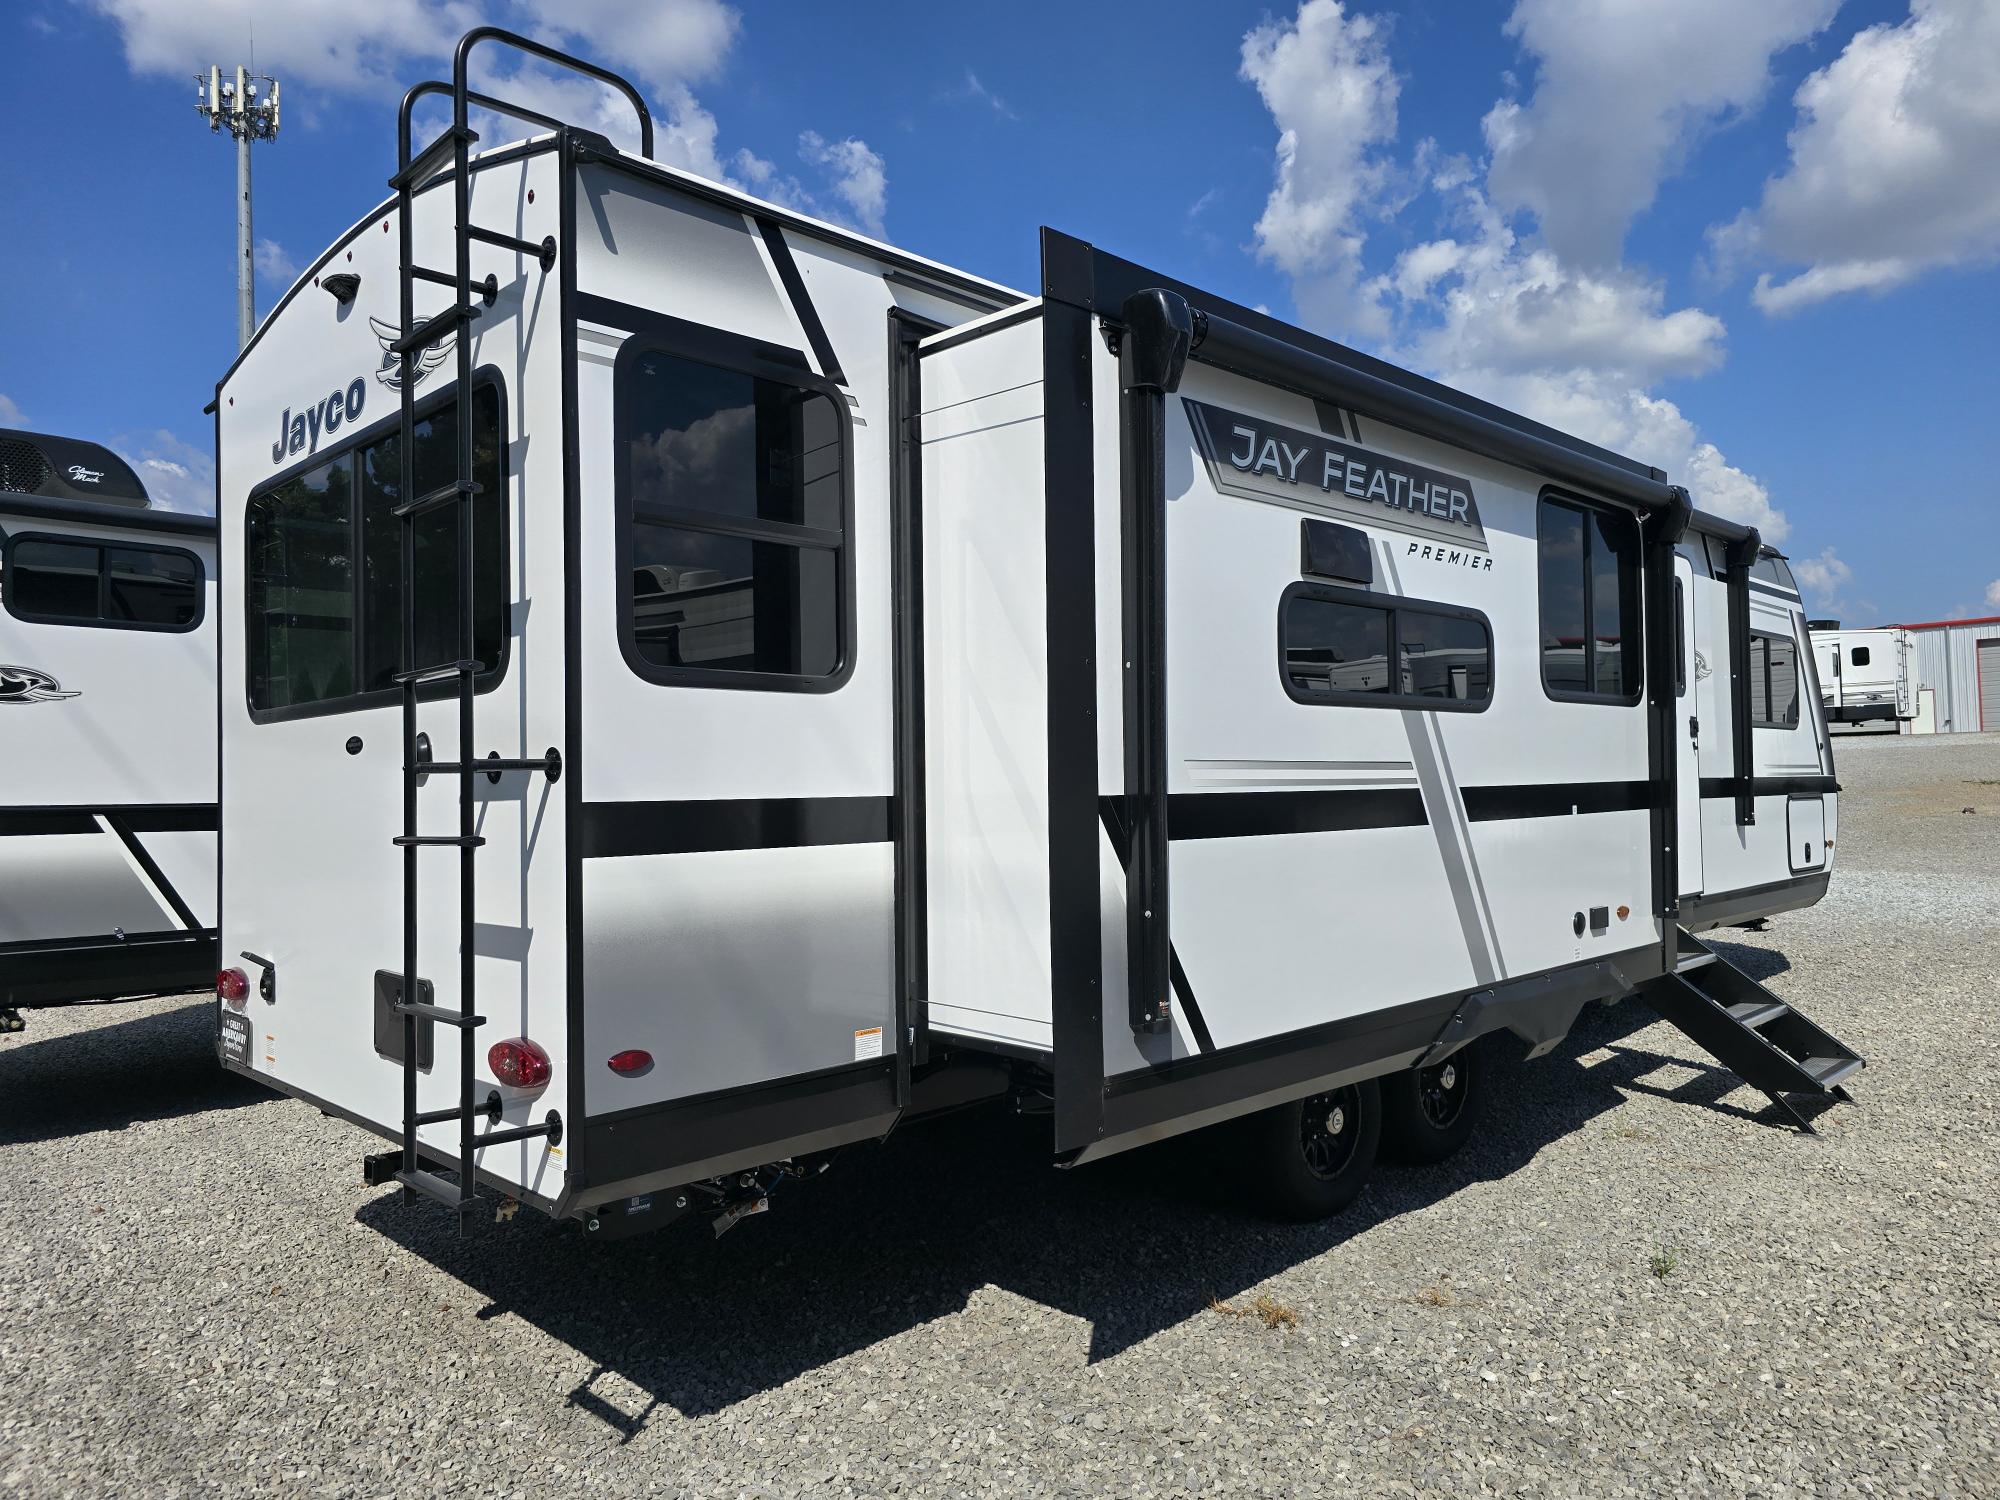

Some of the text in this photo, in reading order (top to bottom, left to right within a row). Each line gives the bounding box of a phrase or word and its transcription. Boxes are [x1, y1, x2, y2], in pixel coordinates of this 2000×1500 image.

[272, 376, 367, 465] Jayco
[1230, 423, 1473, 528] JAY FEATHER
[1406, 542, 1494, 572] PREMIER
[230, 1020, 241, 1031] GREAT
